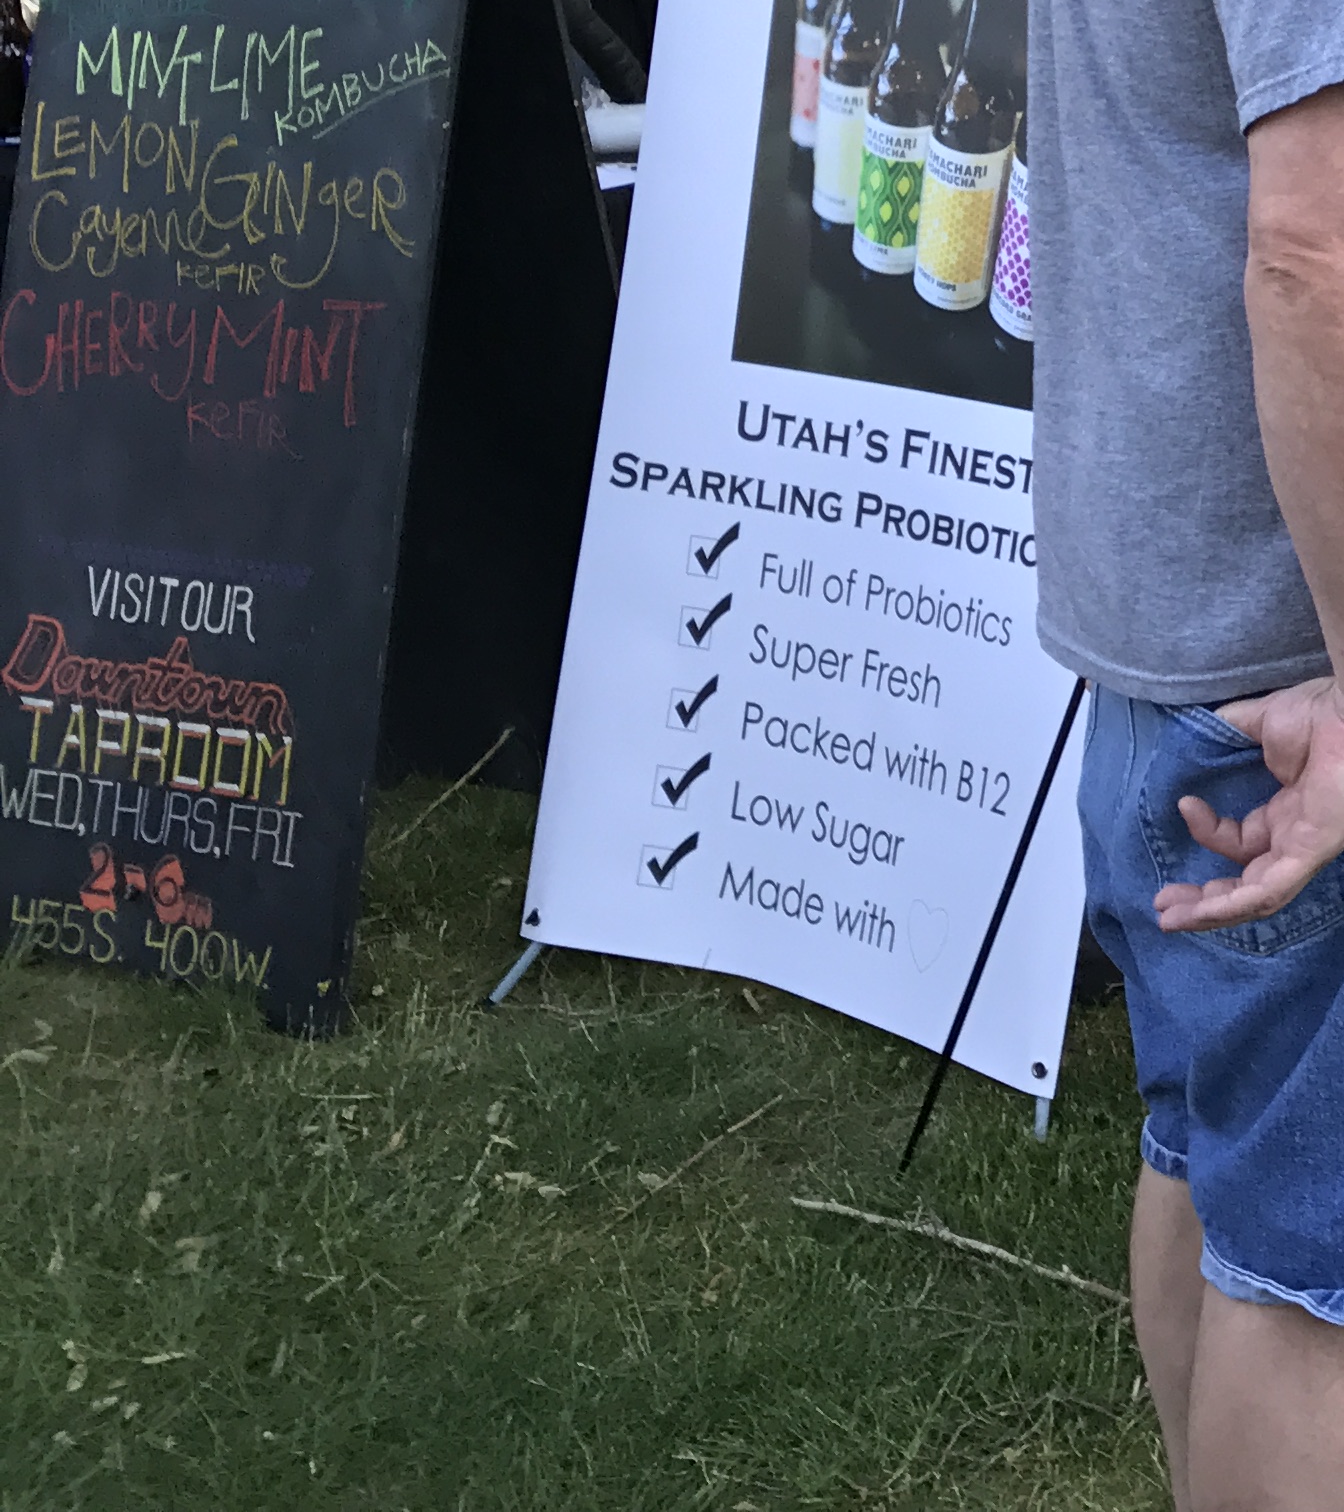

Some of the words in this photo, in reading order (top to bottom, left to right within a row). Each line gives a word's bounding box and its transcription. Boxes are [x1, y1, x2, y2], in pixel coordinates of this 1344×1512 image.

[76, 24, 202, 125] MINT
[209, 24, 324, 120] LIME
[275, 38, 447, 146] KOMBUCHA
[31, 101, 199, 194] LEMON
[204, 299, 387, 427] MINT
[608, 451, 844, 526] SPARKLING
[181, 579, 256, 644] OUR
[759, 551, 812, 600] Full
[823, 567, 857, 607] of
[865, 573, 1013, 649] Probiotics
[1, 613, 289, 736] Downtown
[749, 622, 854, 685] Super
[862, 648, 942, 709] Fresh
[19, 695, 293, 805] TAPROOM
[741, 700, 876, 774] Packed
[883, 744, 949, 797] with
[958, 759, 1013, 819] B12
[731, 780, 805, 834] Low
[811, 801, 907, 876] Sugar
[718, 861, 826, 927] Made
[834, 899, 898, 955] with
